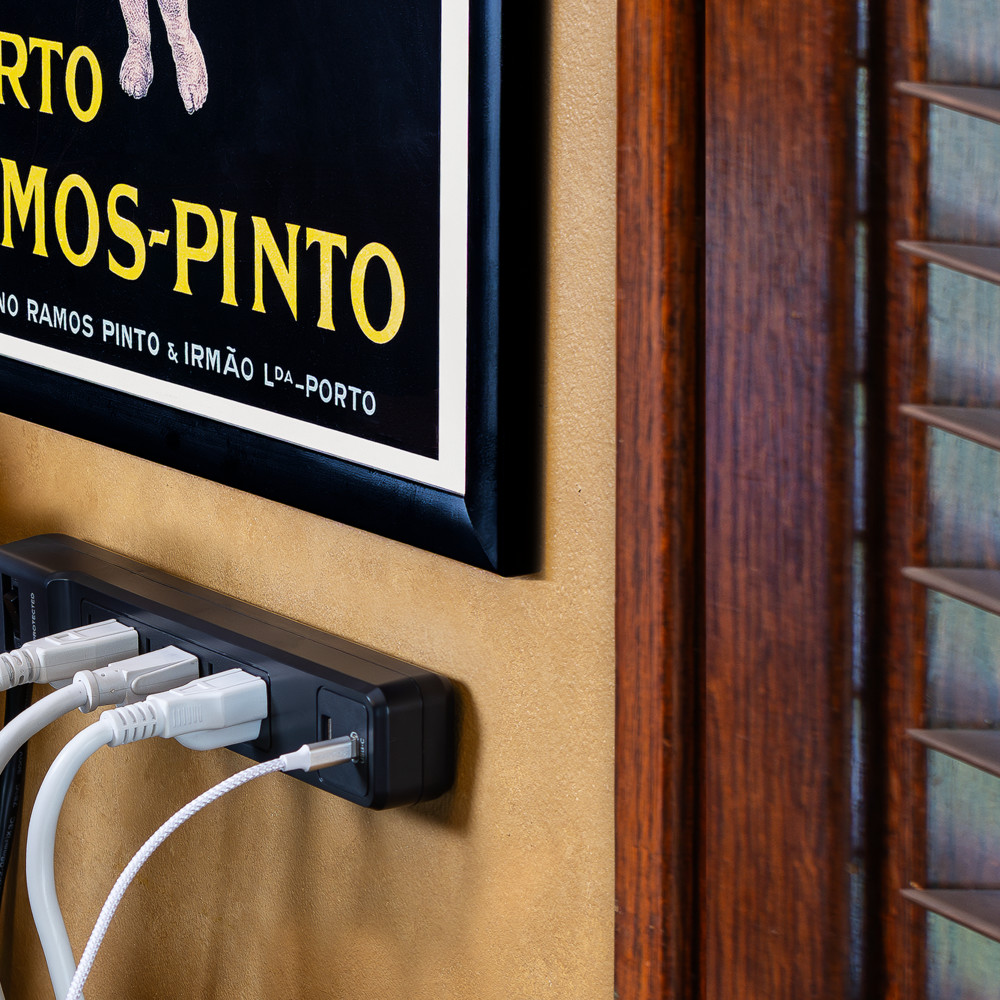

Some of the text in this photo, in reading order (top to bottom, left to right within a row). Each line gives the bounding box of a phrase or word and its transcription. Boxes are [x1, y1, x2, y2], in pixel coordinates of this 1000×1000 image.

[27, 298, 94, 339] RAMOS
[103, 320, 160, 356] PINTO
[167, 342, 179, 365] &
[184, 342, 254, 382] IRMÃO
